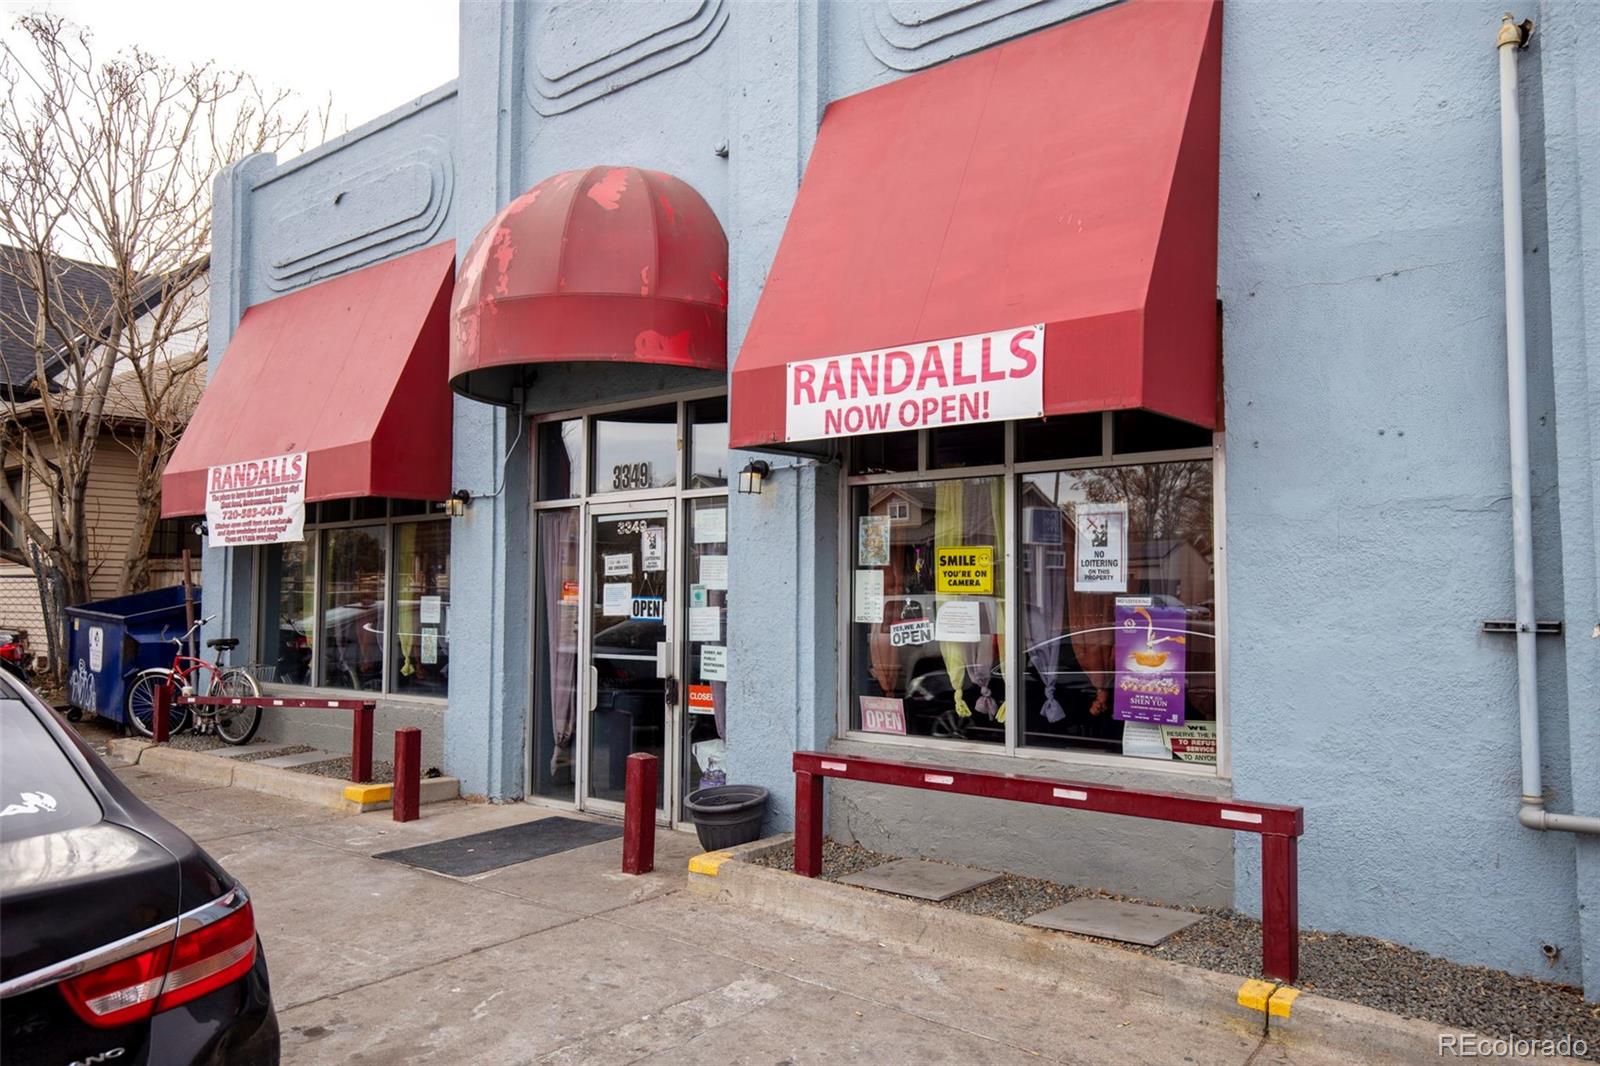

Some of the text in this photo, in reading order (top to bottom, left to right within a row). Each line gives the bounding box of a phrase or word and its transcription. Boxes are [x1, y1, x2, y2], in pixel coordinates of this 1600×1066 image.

[793, 330, 1037, 405] RANDALLS
[824, 390, 990, 435] NOW OPEN!
[211, 454, 302, 490] RANDALLS
[613, 463, 648, 489] 3349
[617, 520, 647, 535] 3349
[939, 555, 976, 566] SMILE
[1081, 559, 1119, 567] LOITERING
[947, 579, 981, 587] CAMERA
[632, 599, 660, 617] OPEN
[892, 629, 932, 645] OPEN
[689, 692, 713, 701] CLOSE
[1130, 697, 1150, 705] SHEN
[1152, 699, 1168, 707] YUN
[865, 710, 903, 731] OPEN
[1194, 754, 1216, 762] ANYON
